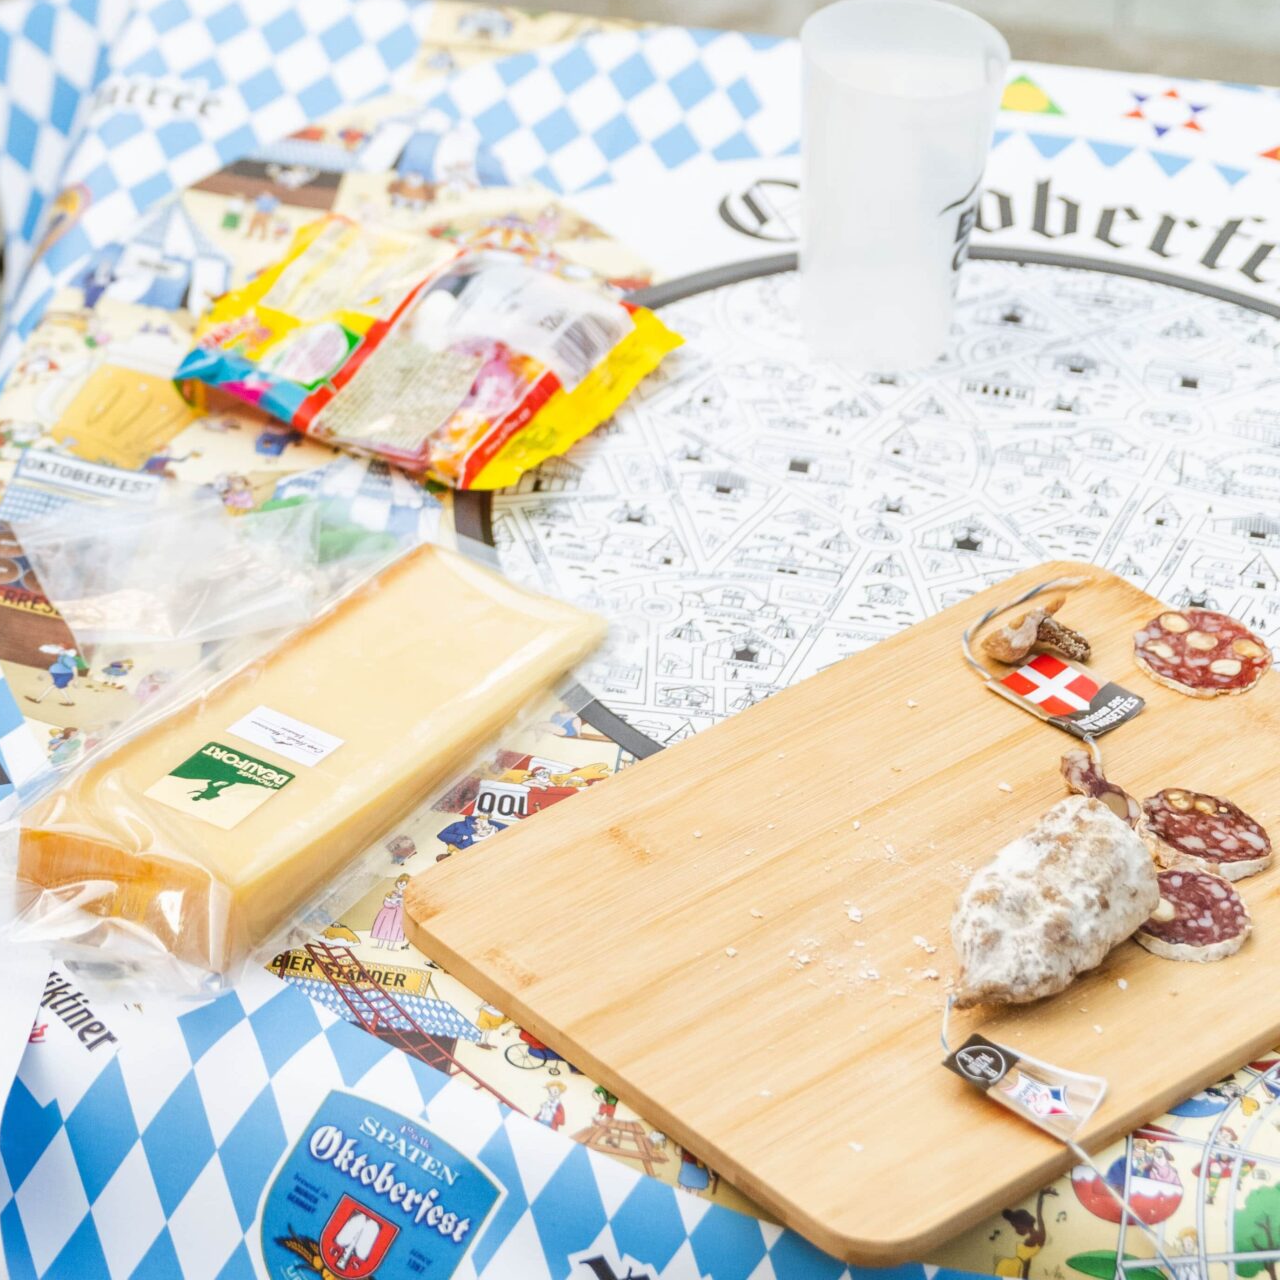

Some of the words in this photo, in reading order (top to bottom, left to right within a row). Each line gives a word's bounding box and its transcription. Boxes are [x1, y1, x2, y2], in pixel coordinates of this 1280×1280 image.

[23, 456, 153, 494] OKTOBERFEST
[202, 745, 290, 787] BEAUFORT
[358, 1116, 460, 1187] SPATEN
[309, 1124, 471, 1243] Oktoberfest
